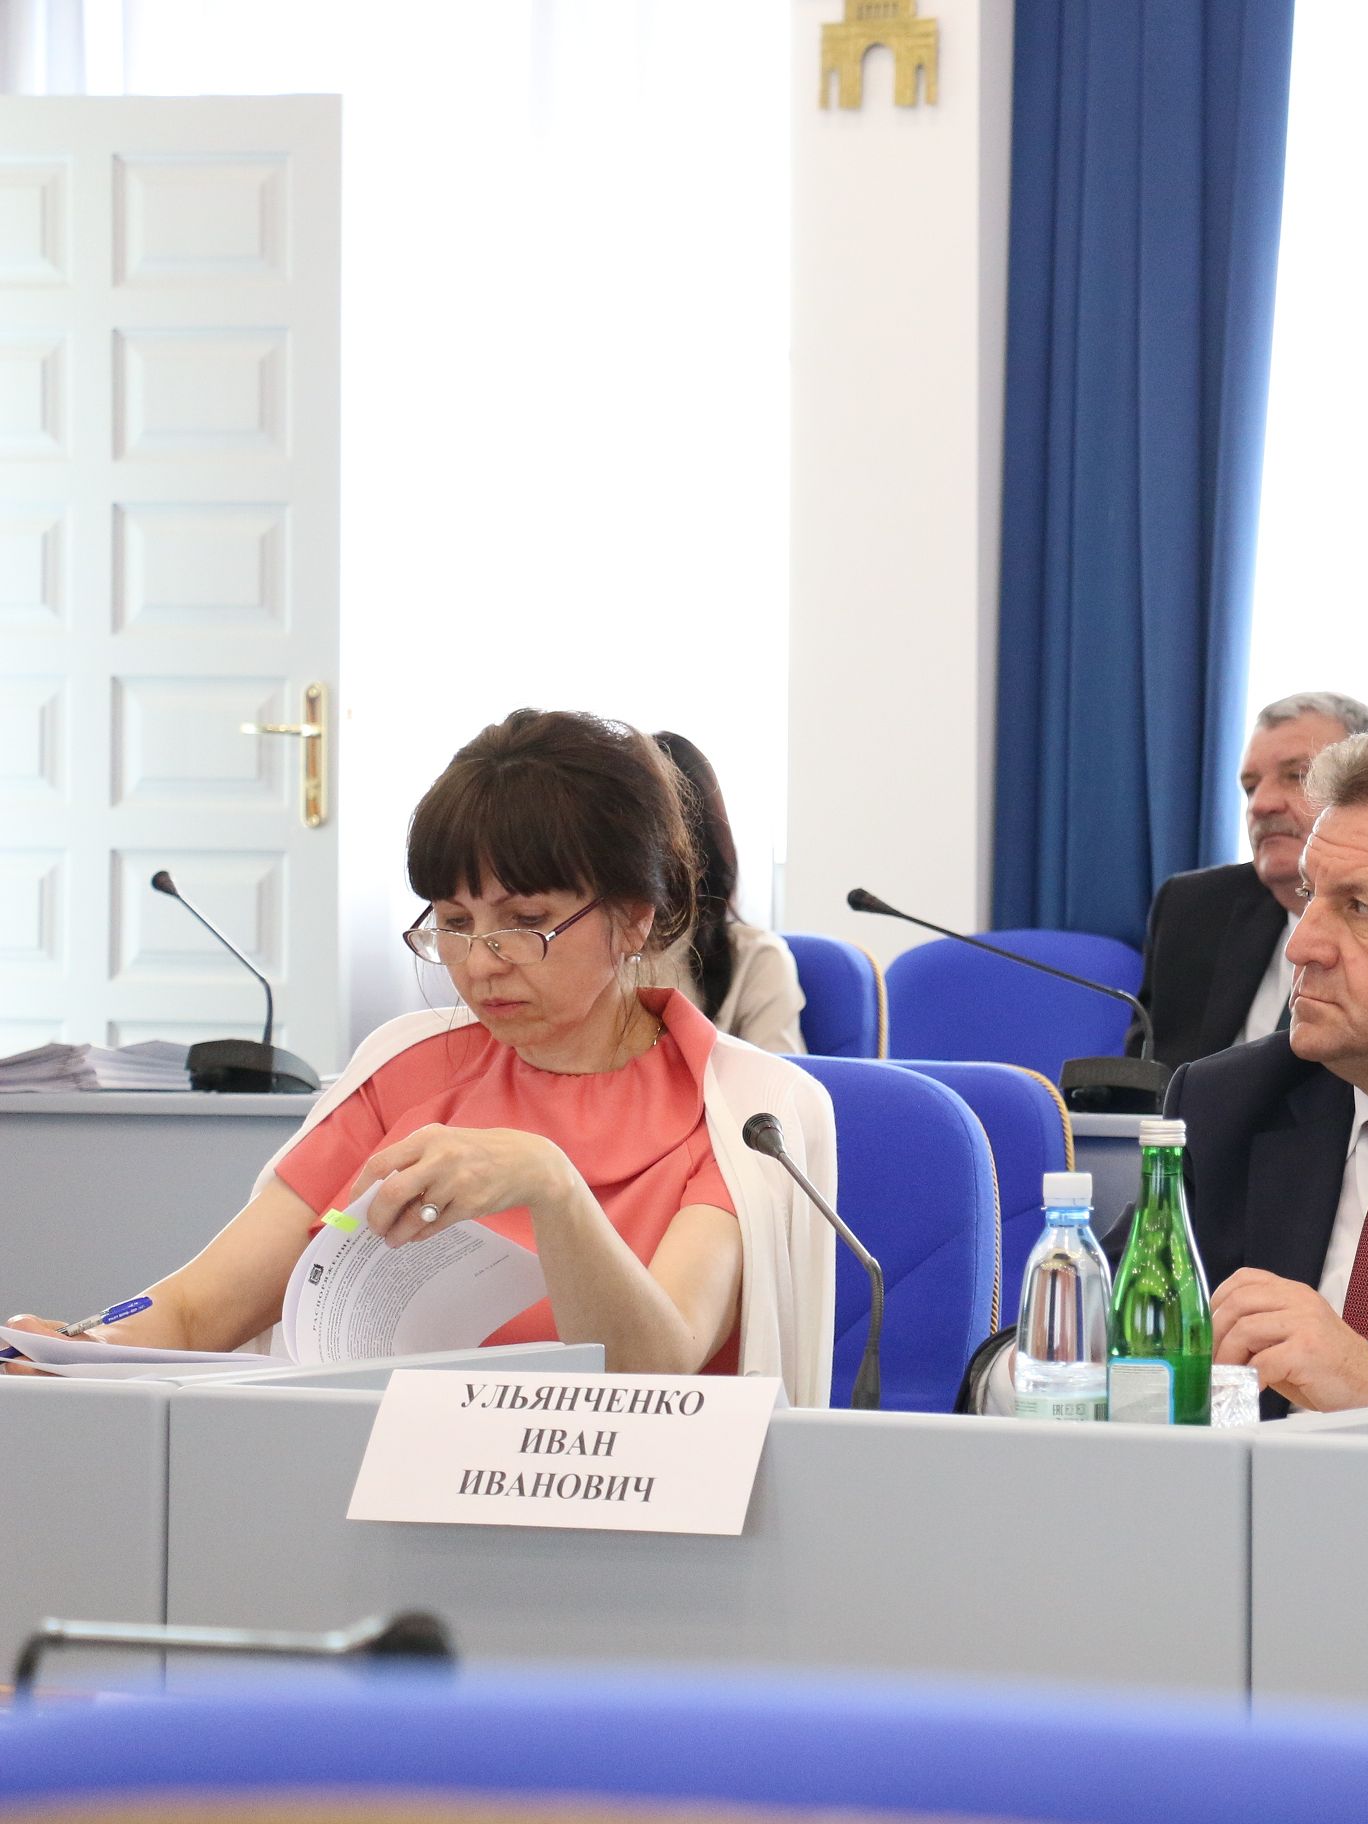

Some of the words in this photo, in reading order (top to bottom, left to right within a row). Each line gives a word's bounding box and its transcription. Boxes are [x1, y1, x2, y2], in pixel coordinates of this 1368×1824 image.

[460, 1383, 706, 1417] УЛЬЯНЧЕНКО
[518, 1427, 619, 1457] ИВАН
[456, 1469, 657, 1503] ИВАНОВИЧ
